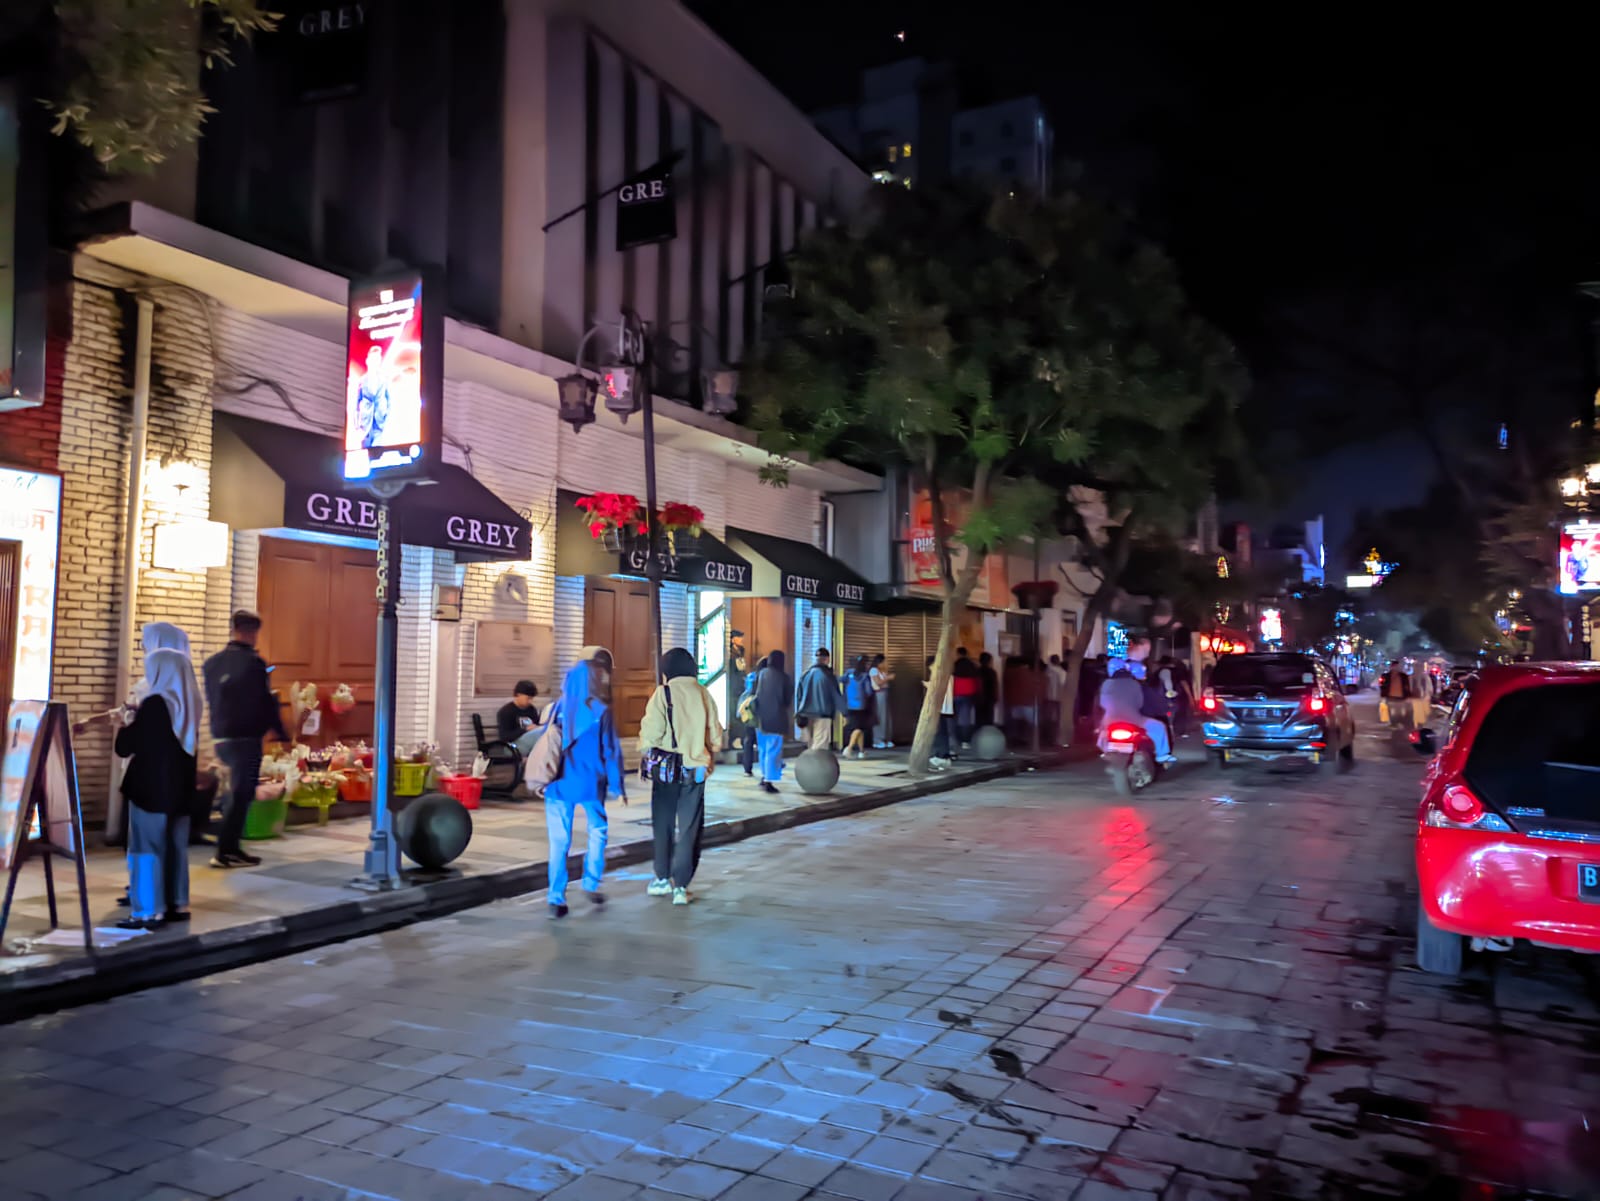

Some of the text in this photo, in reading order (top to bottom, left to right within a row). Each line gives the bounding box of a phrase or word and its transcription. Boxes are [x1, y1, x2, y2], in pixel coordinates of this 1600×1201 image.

[299, 3, 367, 36] GREY
[618, 179, 666, 203] GRE
[306, 492, 378, 528] GRE
[446, 515, 520, 549] GREY
[375, 510, 387, 600] BRAGA
[704, 560, 747, 584] GREY
[786, 574, 820, 596] GREY
[836, 583, 865, 602] GREY
[1584, 867, 1598, 887] B
